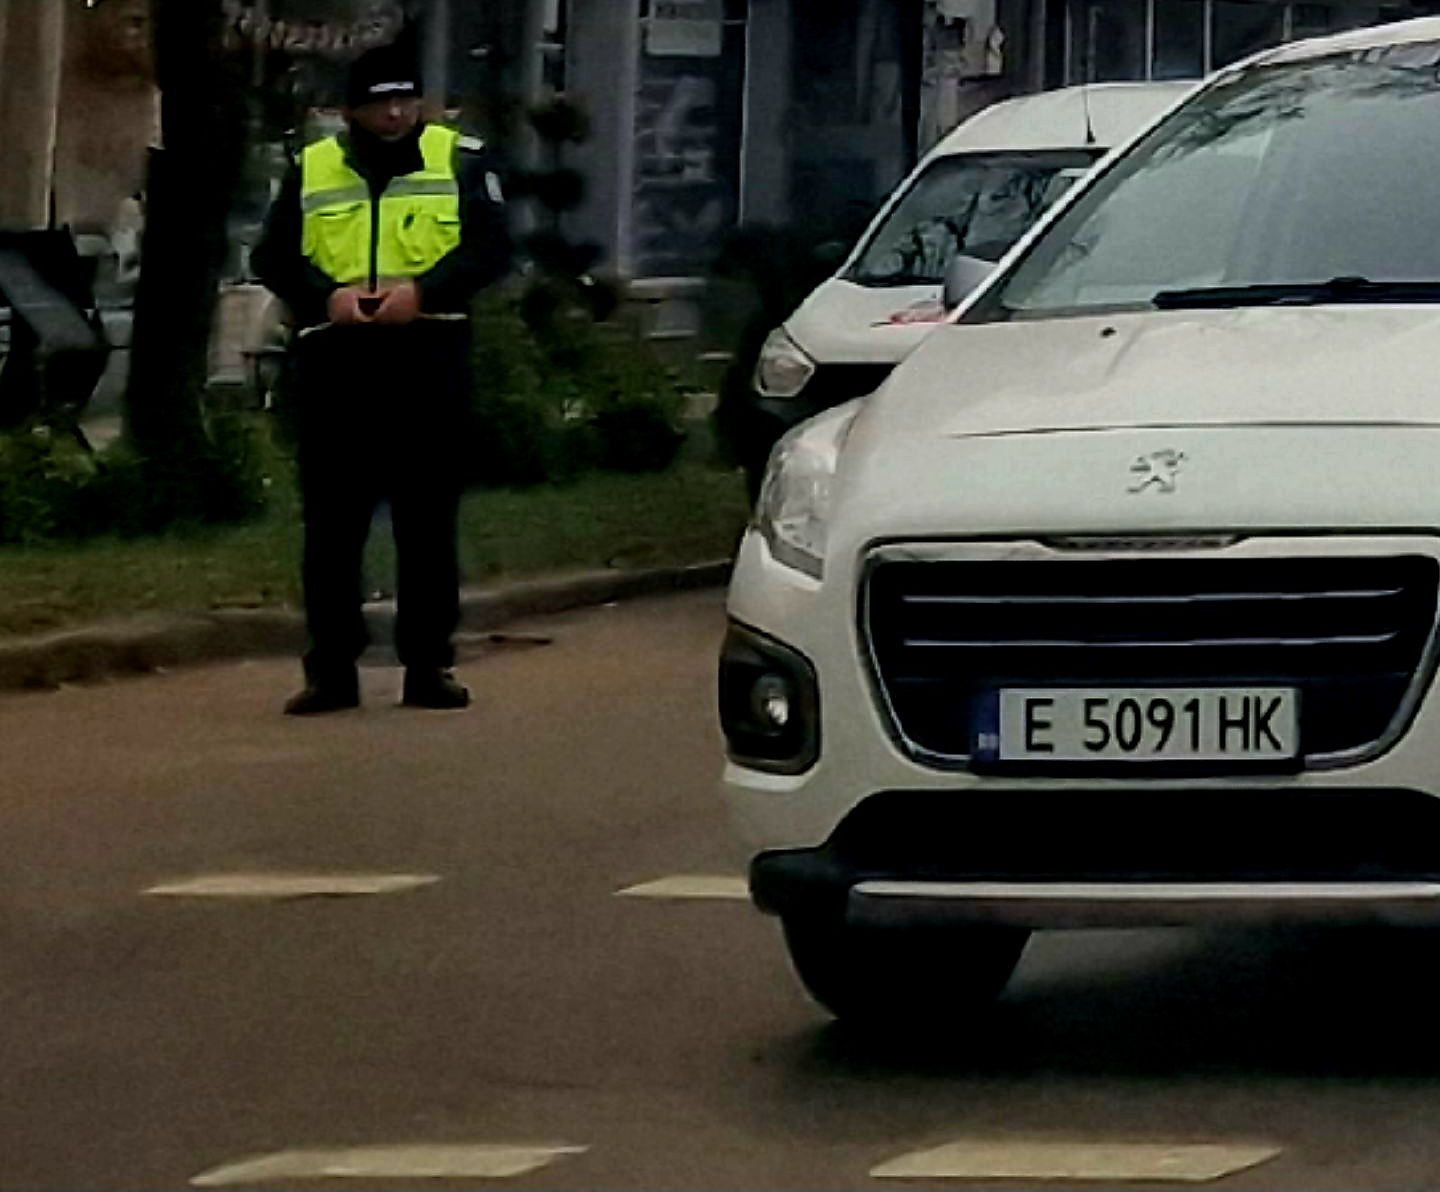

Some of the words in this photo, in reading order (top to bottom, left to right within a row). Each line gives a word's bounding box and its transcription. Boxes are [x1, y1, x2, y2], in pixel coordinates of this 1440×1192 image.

[1025, 698, 1054, 752] E
[1083, 698, 1200, 752] 5091
[1219, 696, 1282, 752] HK
